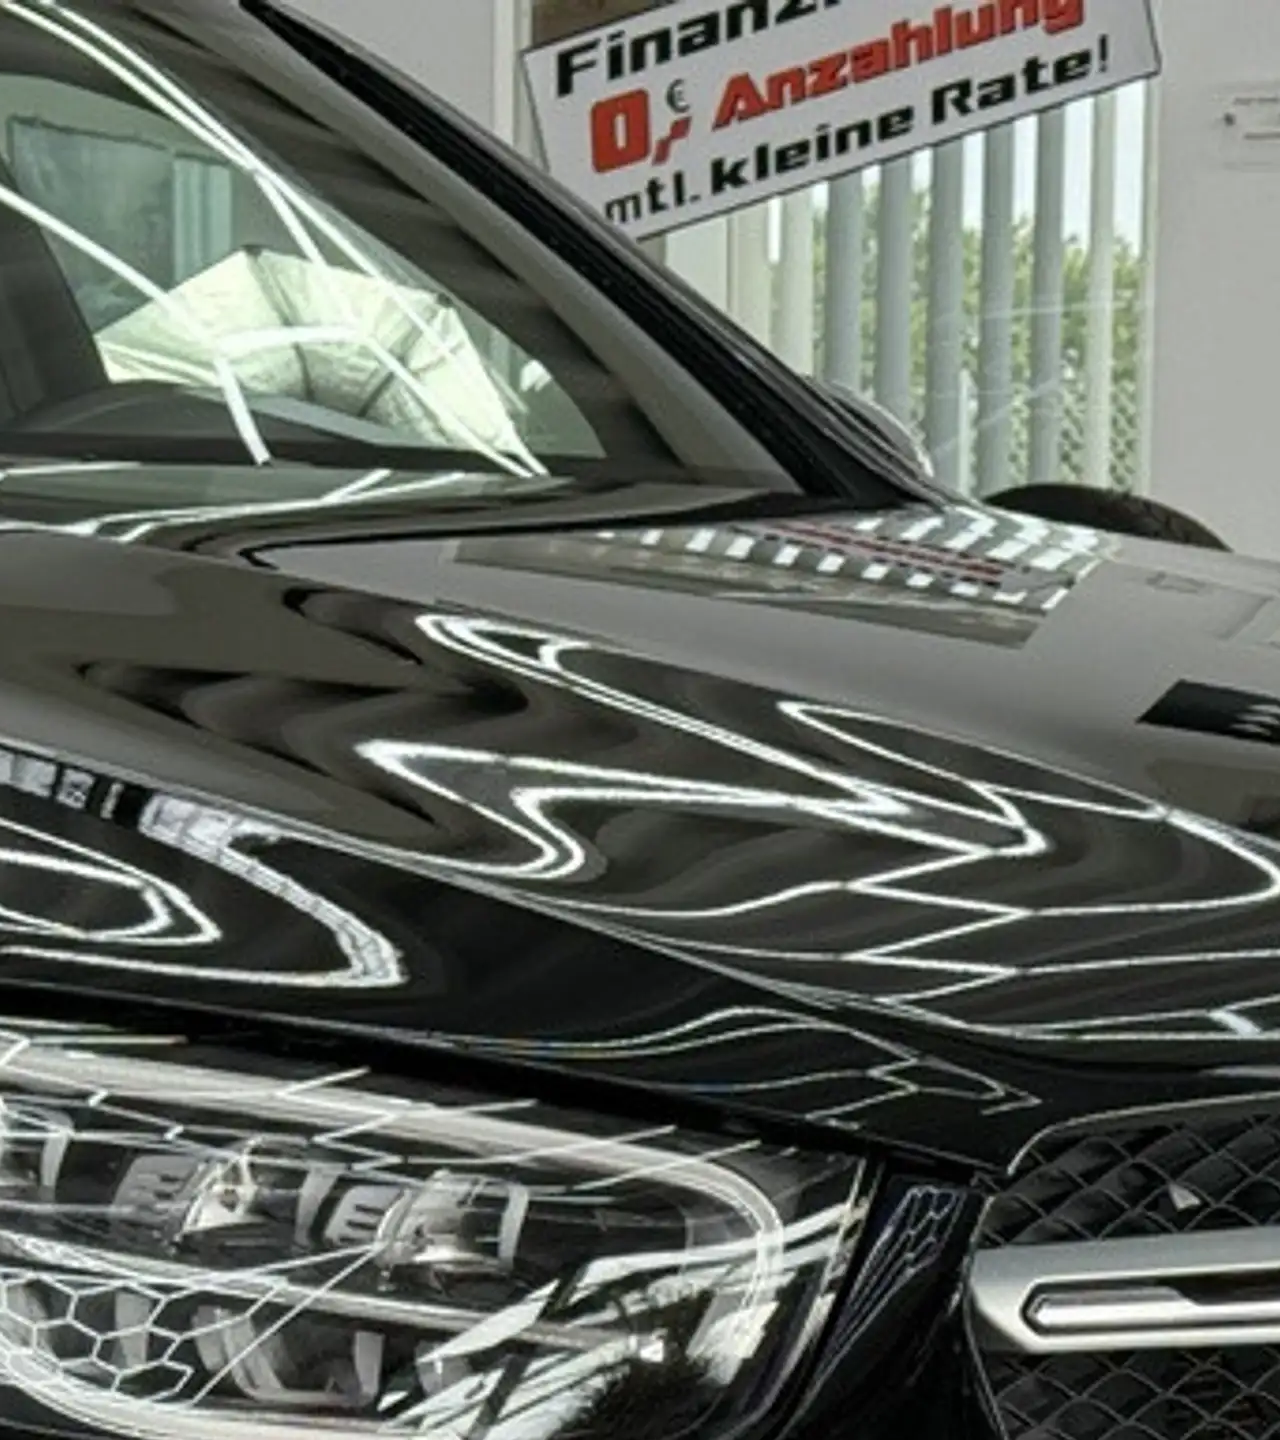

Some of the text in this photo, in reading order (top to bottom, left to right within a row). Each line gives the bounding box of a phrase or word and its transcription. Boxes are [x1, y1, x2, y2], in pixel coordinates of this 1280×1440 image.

[556, 0, 840, 98] Finanz
[666, 79, 691, 113] €
[711, 0, 1084, 131] Anzahlung
[605, 33, 1109, 224] mtl. kleine Rate!
